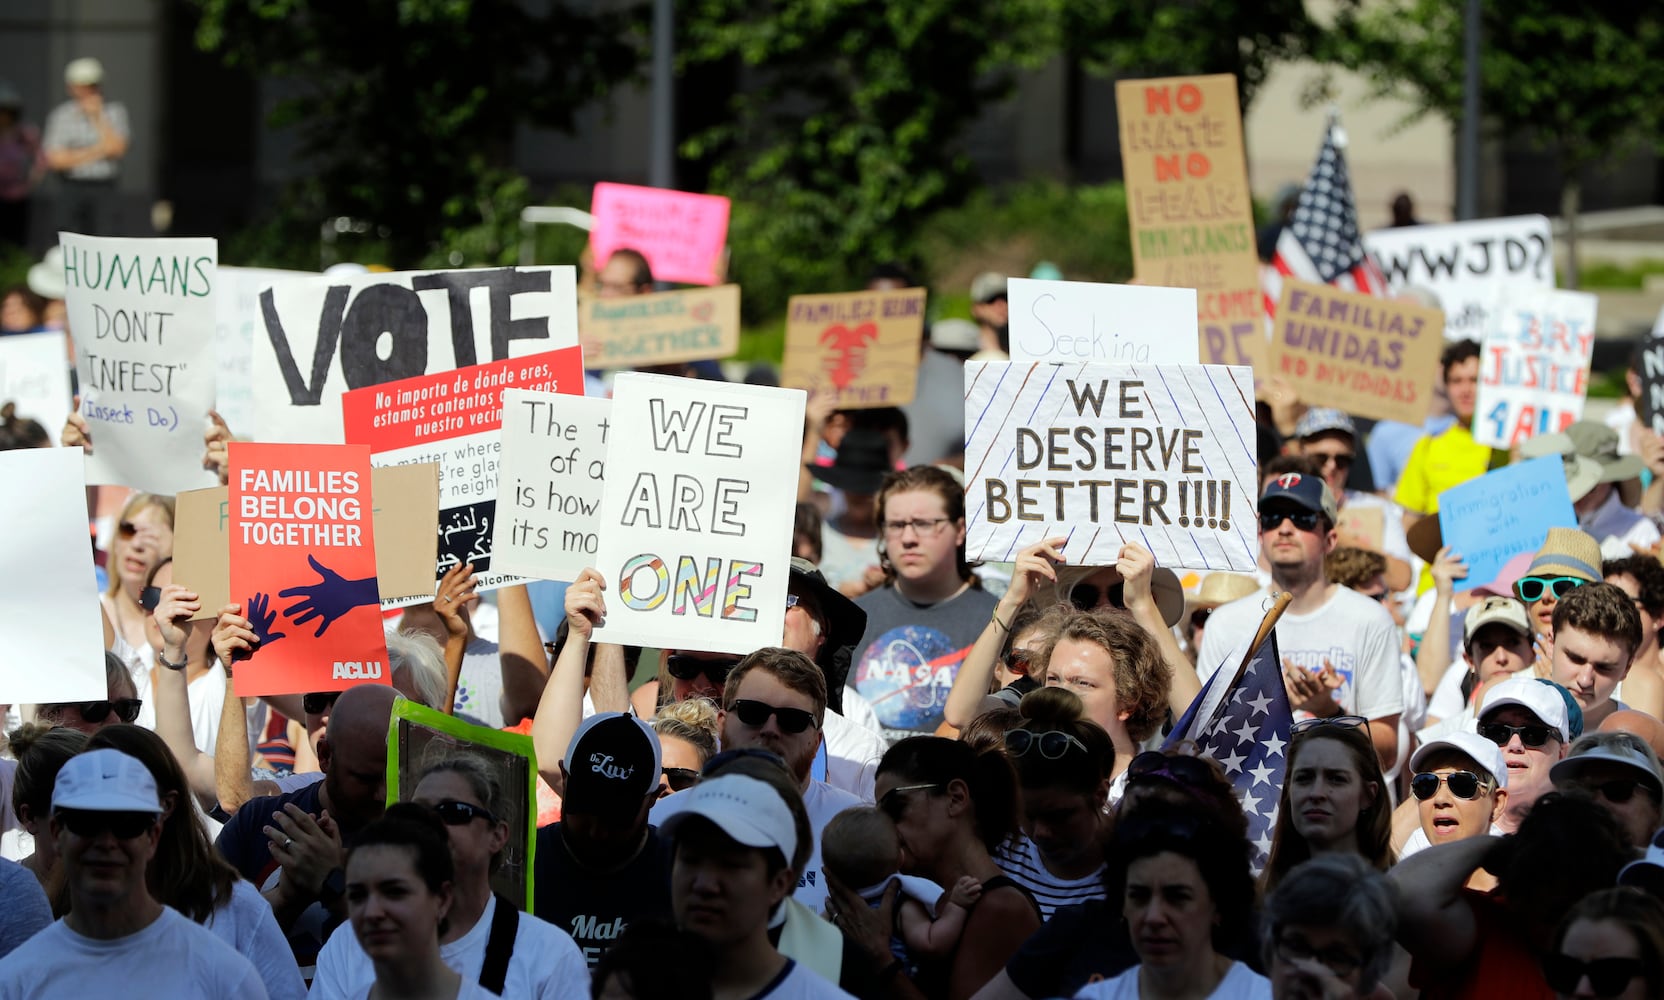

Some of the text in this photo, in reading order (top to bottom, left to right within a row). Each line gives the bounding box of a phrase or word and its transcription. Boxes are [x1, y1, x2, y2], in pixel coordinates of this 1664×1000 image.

[1144, 84, 1204, 116] NO
[1154, 152, 1211, 183] NO
[1134, 184, 1245, 224] FEAR
[63, 245, 212, 296] HUMANS
[1373, 234, 1546, 282] WWJD?
[92, 303, 174, 345] DON'T
[259, 267, 551, 405] VOTE
[1284, 319, 1404, 371] UNIDAS
[375, 364, 553, 410] No importa de dónde eres,
[1066, 379, 1144, 419] WE
[82, 395, 178, 431] (Insects Do)
[373, 404, 425, 428] estamos
[430, 392, 494, 416] contentos
[415, 407, 502, 437] nuestro vecin
[522, 400, 577, 440] The
[649, 398, 749, 458] WE
[1488, 401, 1508, 439] 4
[455, 442, 501, 460] where
[550, 447, 580, 475] of
[1016, 426, 1204, 473] DESERVE
[240, 469, 359, 494] FAMILIES
[516, 479, 600, 516] is how
[241, 495, 361, 521] BELONG
[620, 472, 750, 537] ARE
[984, 478, 1231, 531] BETTER!!!!
[240, 522, 362, 547] TOGETHER
[512, 519, 549, 549] its
[619, 553, 764, 622] ONE
[332, 661, 382, 680] ACLU
[866, 659, 953, 698] NASA
[571, 914, 628, 939] Mak
